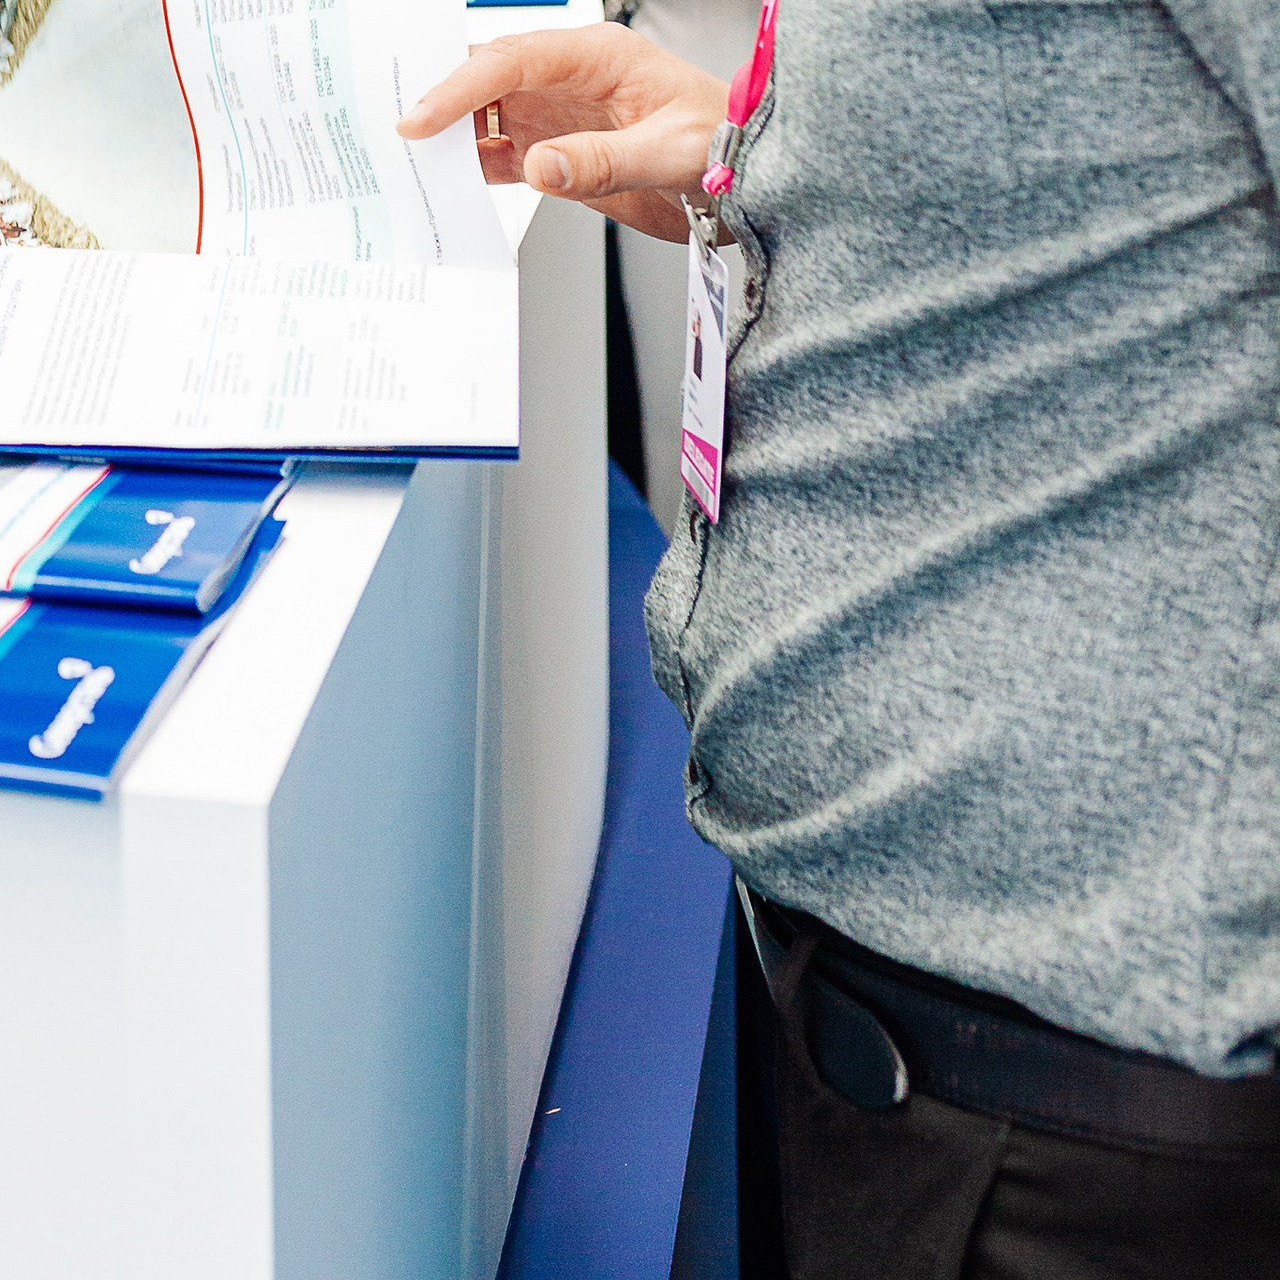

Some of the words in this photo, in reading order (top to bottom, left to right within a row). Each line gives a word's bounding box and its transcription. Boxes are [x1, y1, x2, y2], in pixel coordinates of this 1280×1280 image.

[310, 18, 319, 40] 2020
[314, 73, 325, 97] ГОСТ
[326, 83, 334, 96] EN
